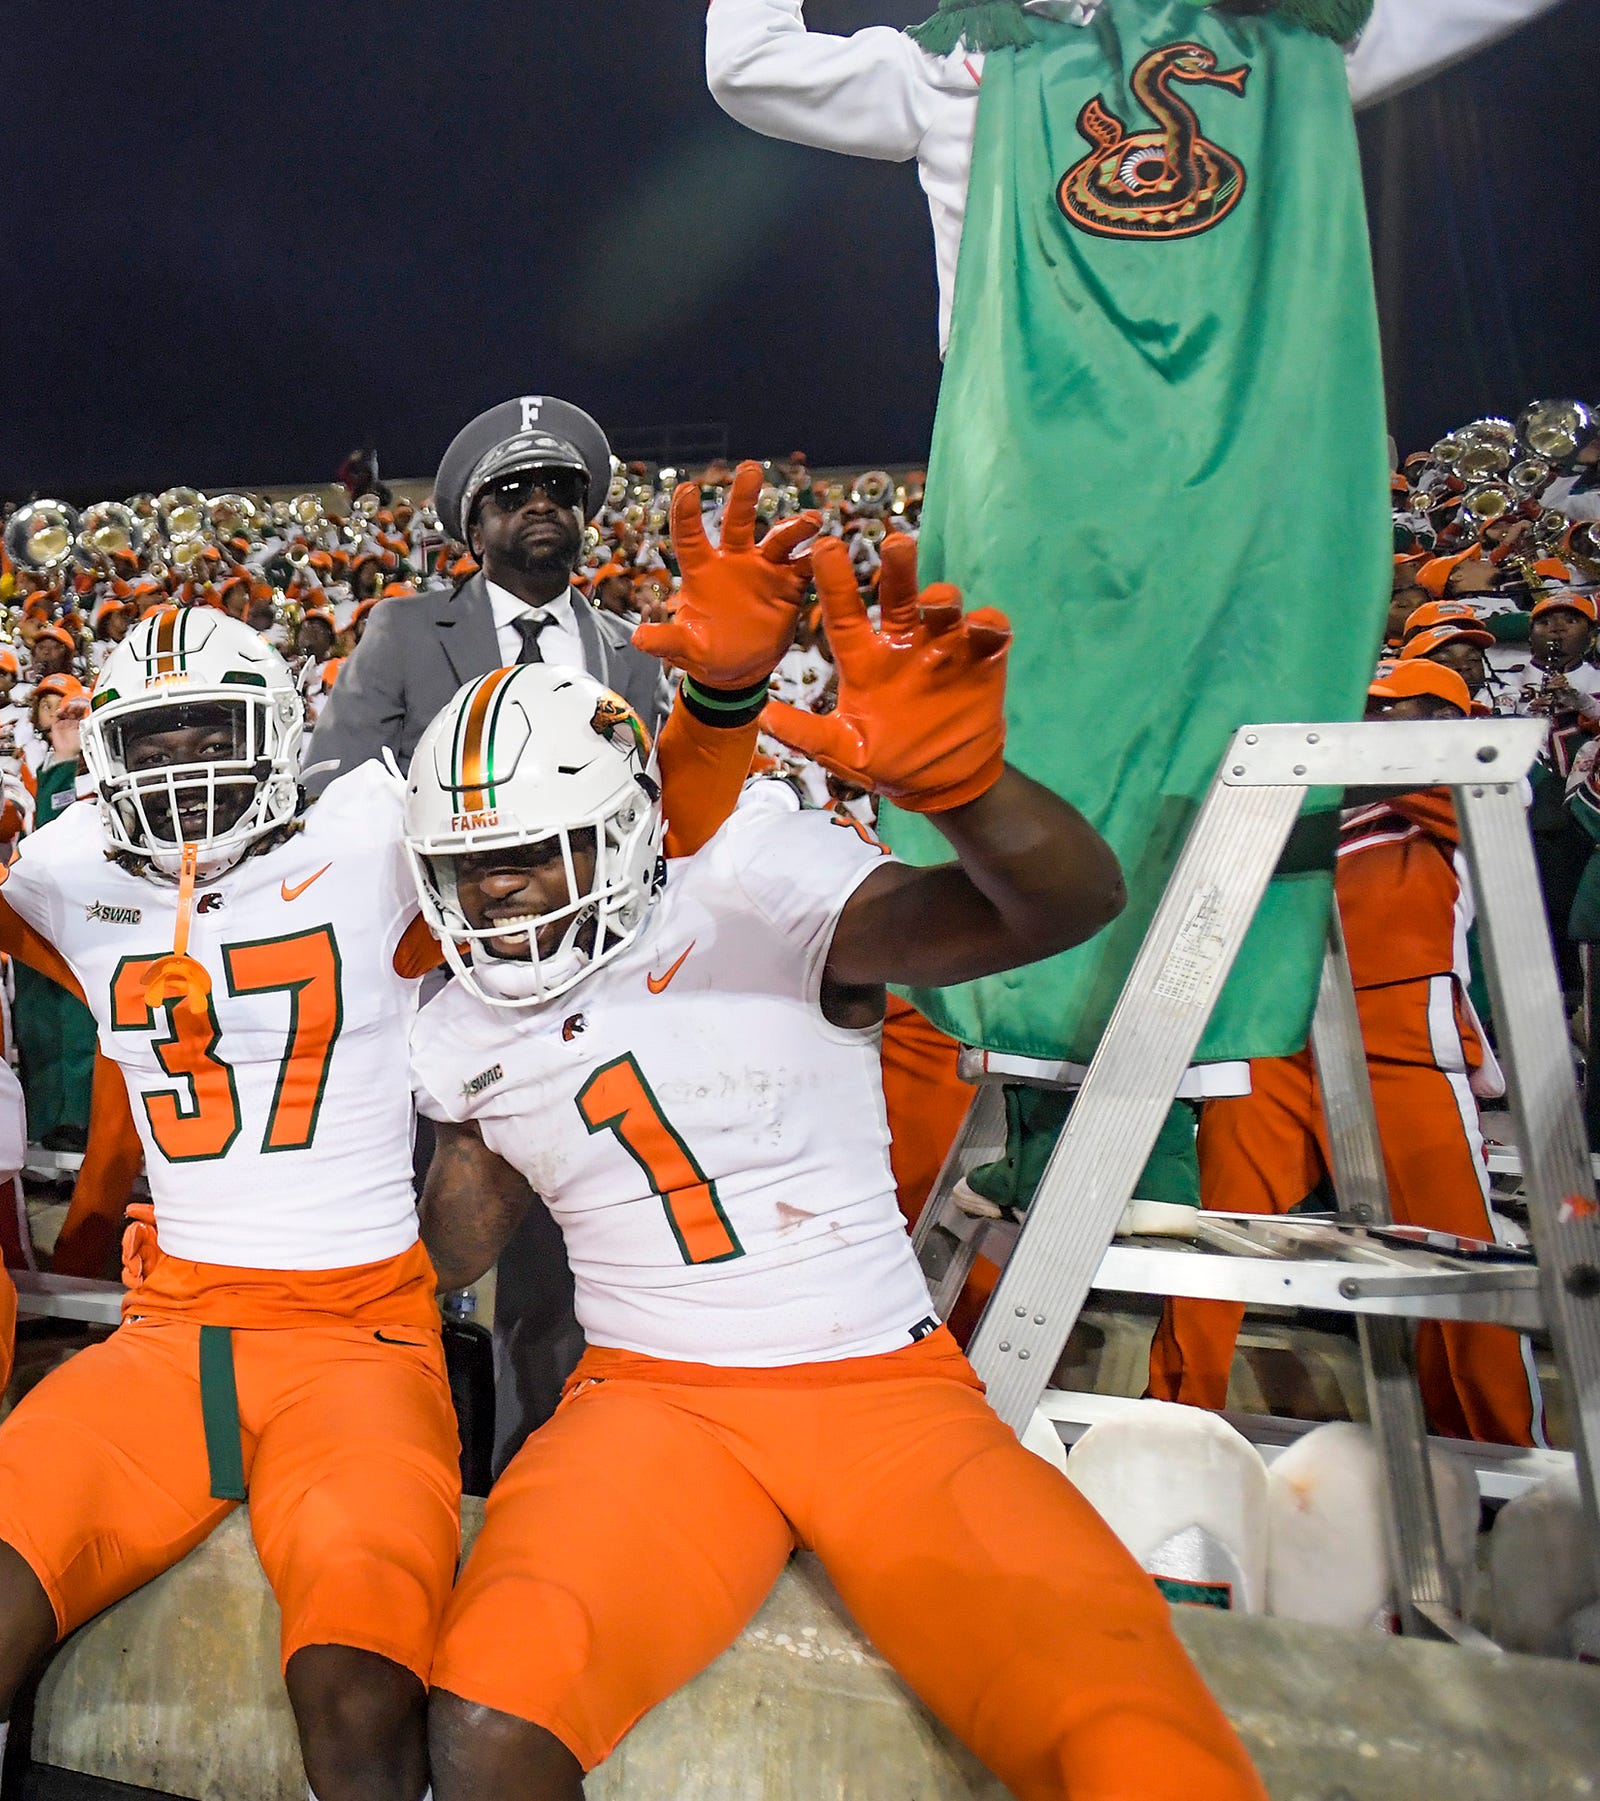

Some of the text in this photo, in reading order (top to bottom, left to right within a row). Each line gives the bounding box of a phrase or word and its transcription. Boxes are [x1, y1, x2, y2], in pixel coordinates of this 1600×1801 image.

[520, 397, 543, 431] F
[145, 672, 189, 689] FAMU
[451, 811, 498, 832] FAMU
[101, 905, 141, 924] SWAC
[109, 922, 344, 1164] 37
[469, 1063, 503, 1094] SWAC
[574, 1050, 746, 1265] 1
